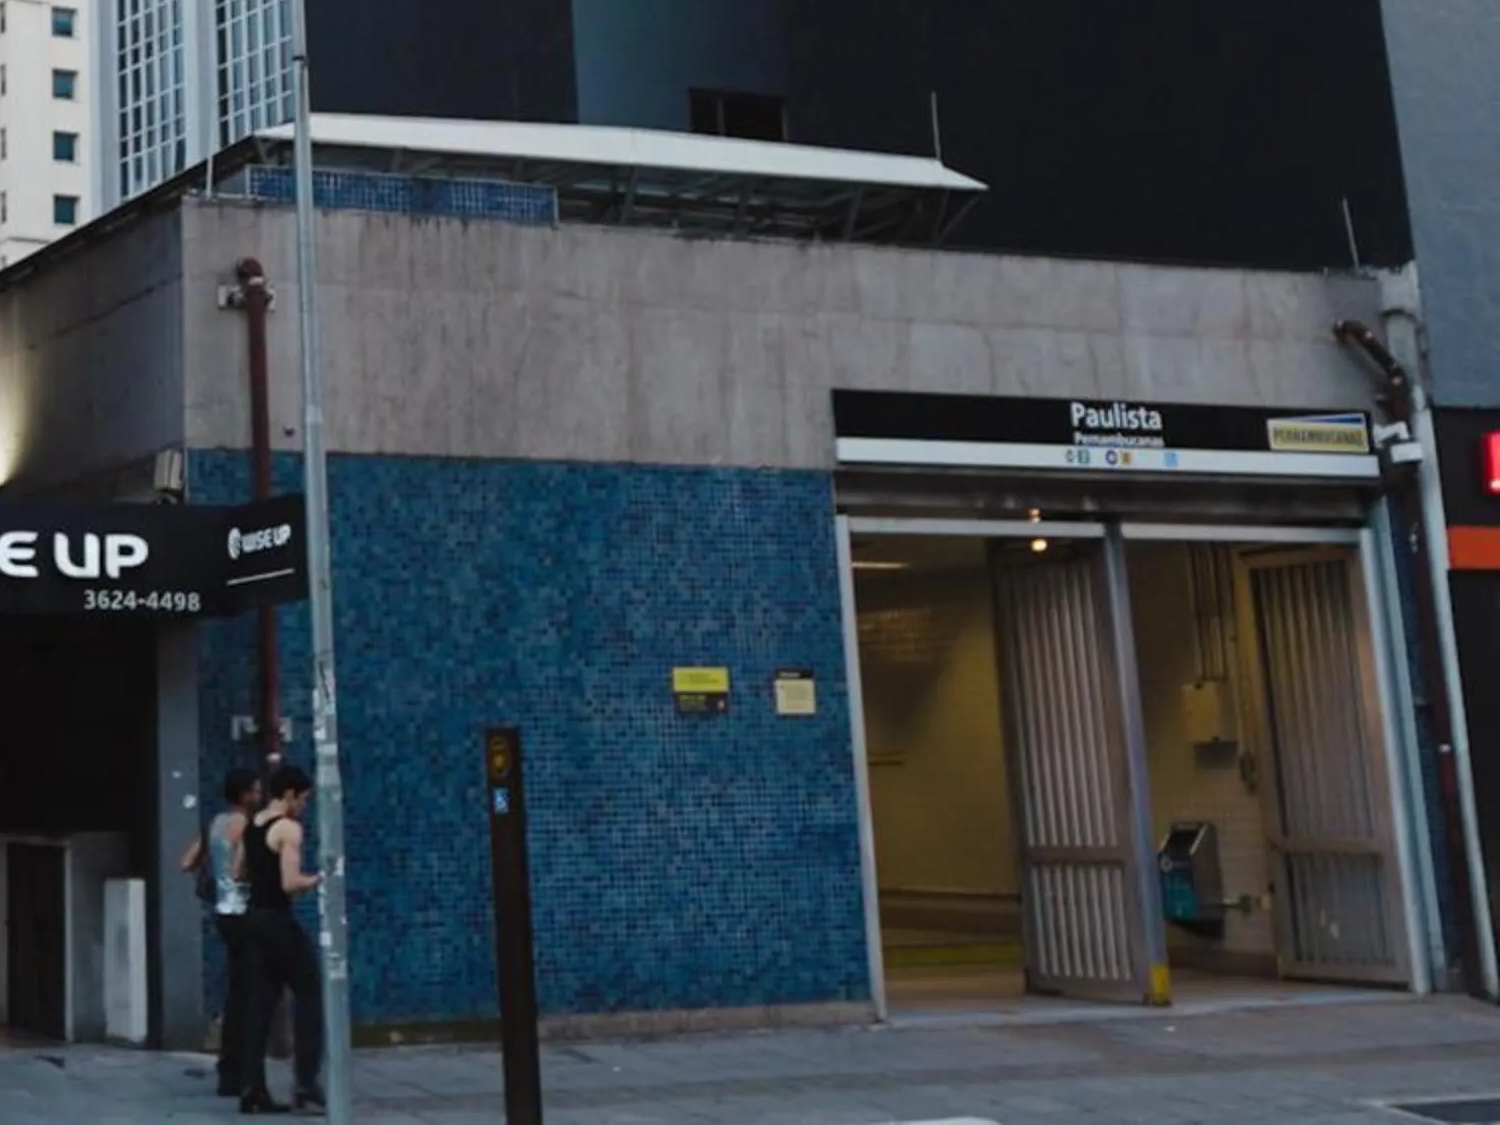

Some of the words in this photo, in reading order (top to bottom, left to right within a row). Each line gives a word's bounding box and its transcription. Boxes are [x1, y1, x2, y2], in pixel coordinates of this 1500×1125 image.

[1070, 401, 1162, 431] Paulista
[241, 527, 273, 553] WISE
[273, 523, 292, 546] UP
[53, 532, 149, 579] UP
[83, 589, 201, 613] 3624-4498
